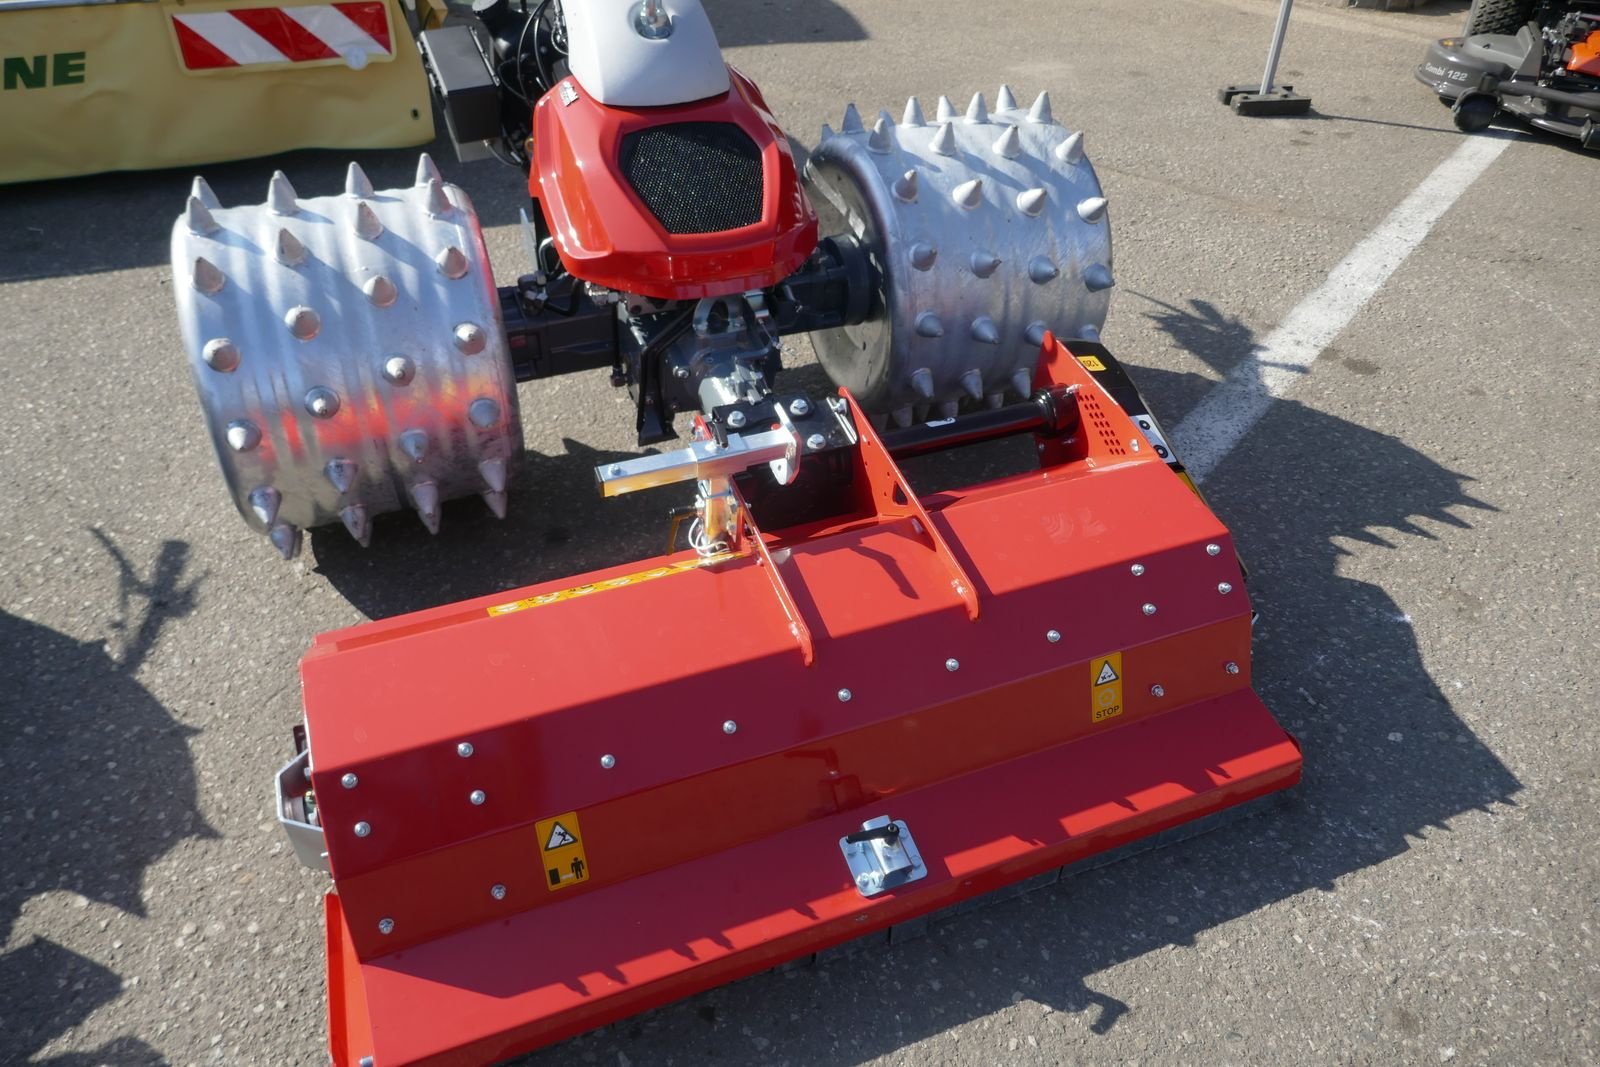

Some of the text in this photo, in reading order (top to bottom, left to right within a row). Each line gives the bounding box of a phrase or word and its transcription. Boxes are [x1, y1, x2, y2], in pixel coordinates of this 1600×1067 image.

[4, 52, 86, 90] NE
[1425, 62, 1468, 81] Combi 122
[1096, 705, 1120, 719] STOP
